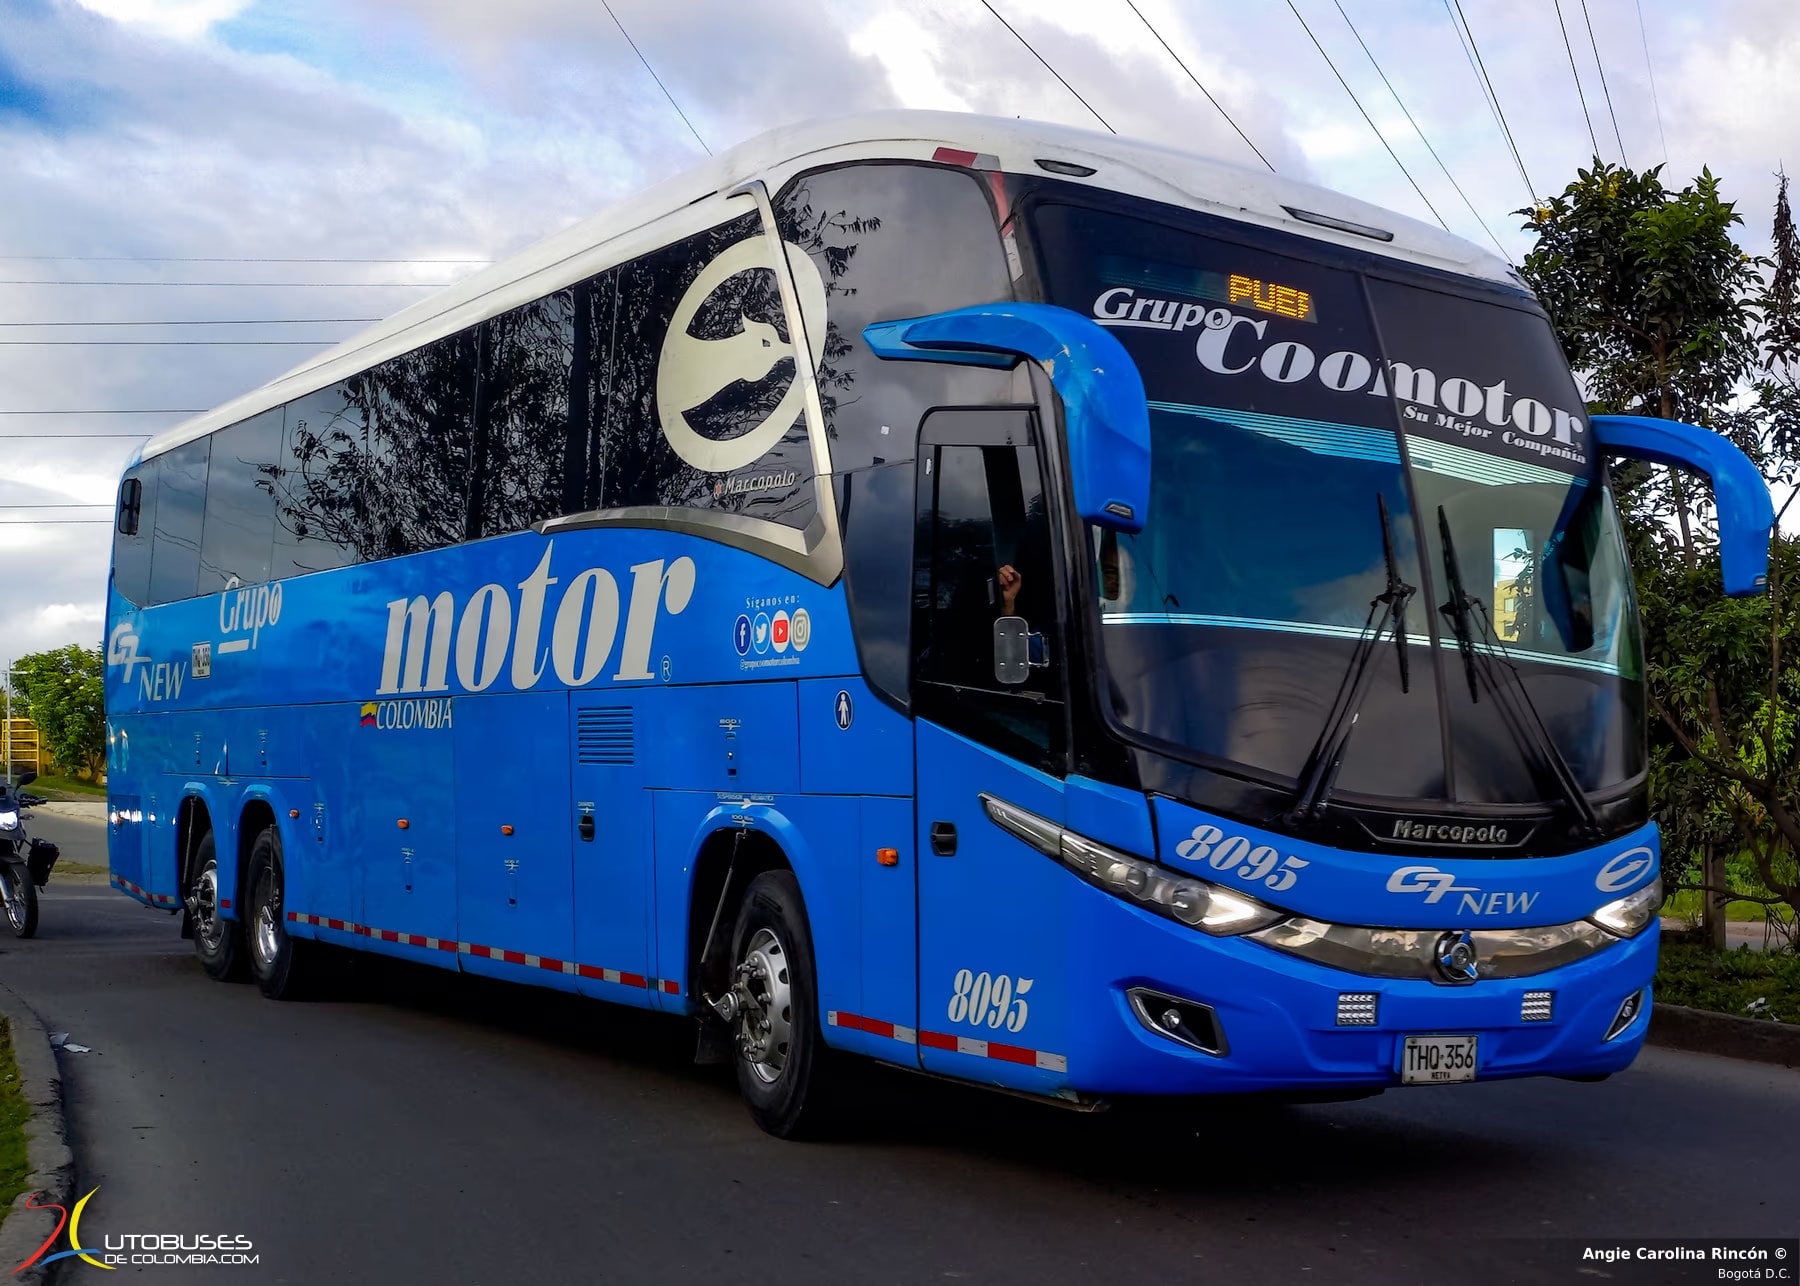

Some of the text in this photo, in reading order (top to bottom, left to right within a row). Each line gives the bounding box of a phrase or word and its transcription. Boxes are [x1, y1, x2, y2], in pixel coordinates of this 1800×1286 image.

[1093, 287, 1231, 332] Grupo
[1196, 315, 1583, 447] Coomotor
[1403, 405, 1428, 423] Su
[1434, 413, 1493, 438] Mejor
[724, 470, 796, 494] Marcopolo
[219, 576, 283, 650] Grupo
[375, 539, 696, 695] motor
[138, 661, 188, 701] NEW
[376, 698, 453, 730] COLOMBIA
[1393, 820, 1508, 843] Marcopolo
[1176, 825, 1310, 891] 8095
[1456, 892, 1540, 915] NEW
[948, 969, 1034, 1033] 8095
